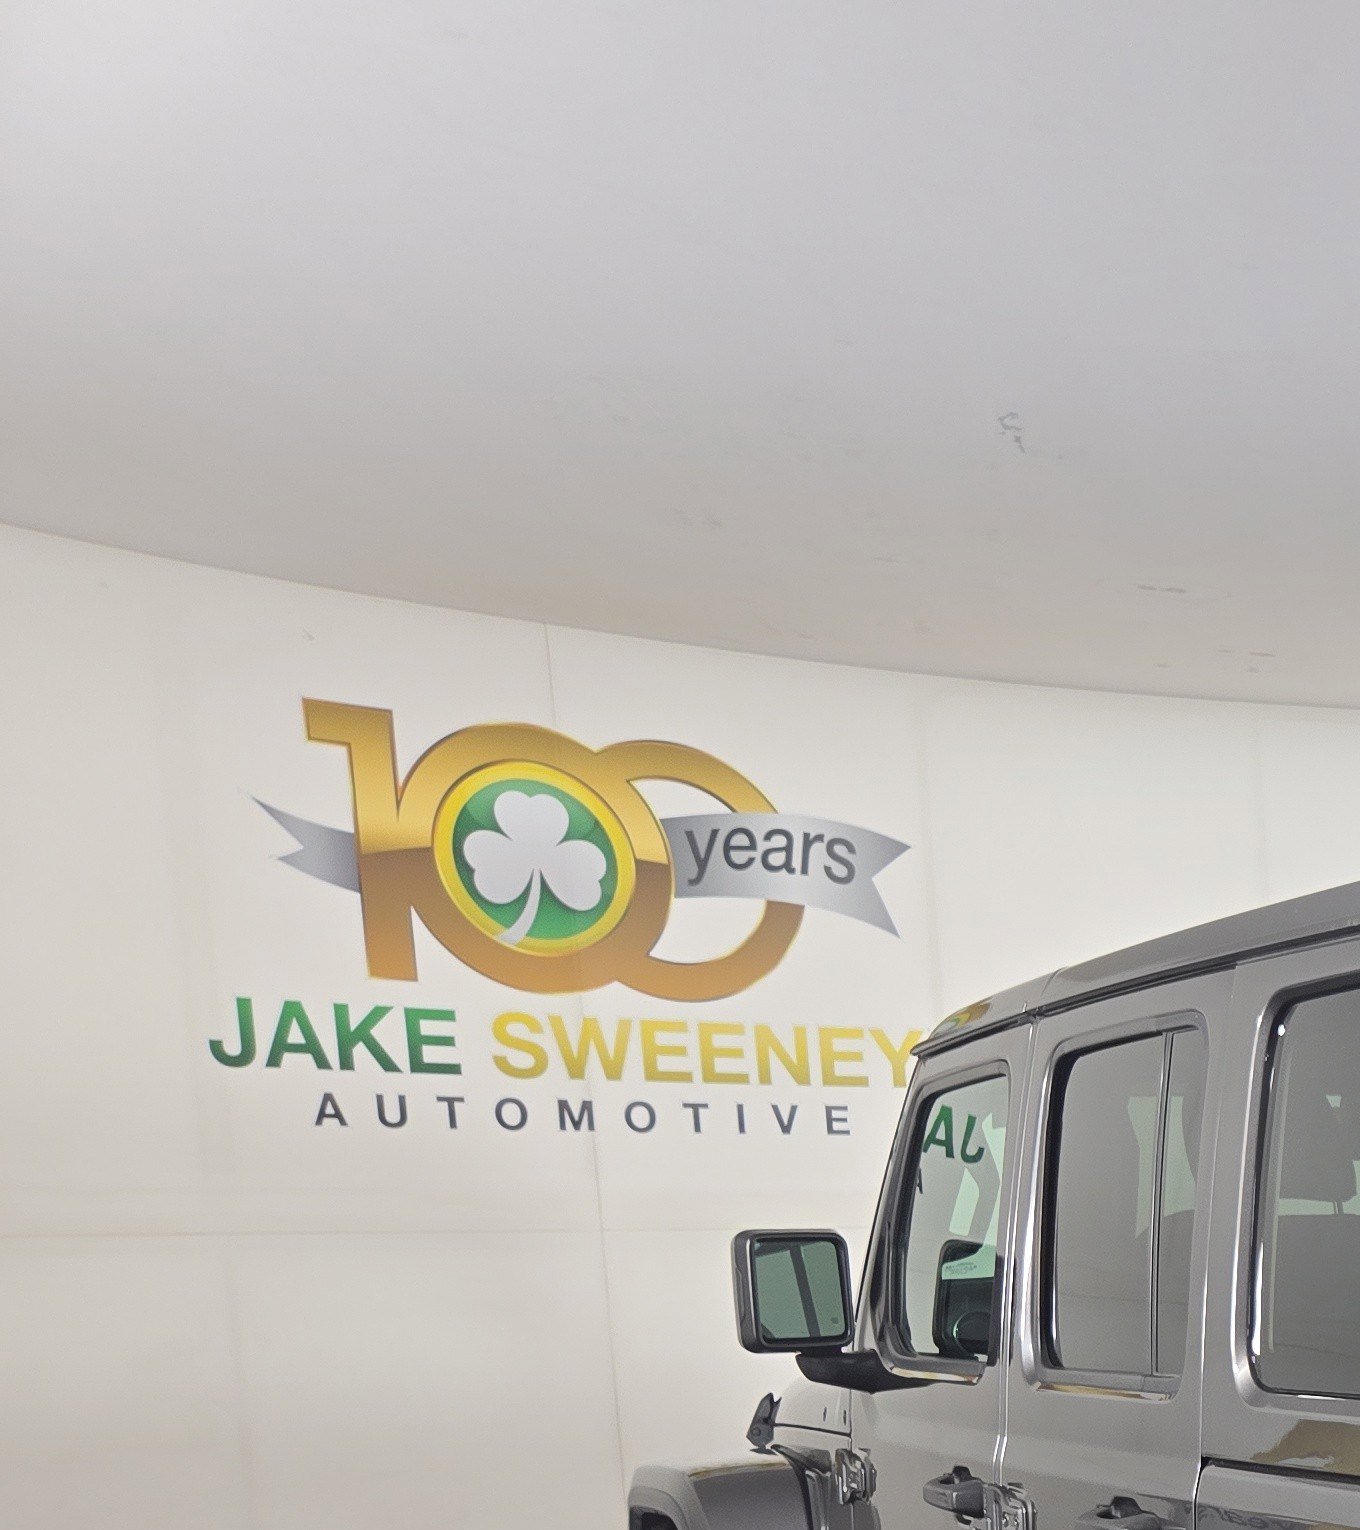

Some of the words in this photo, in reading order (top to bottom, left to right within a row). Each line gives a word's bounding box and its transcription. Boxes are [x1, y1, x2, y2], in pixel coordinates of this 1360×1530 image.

[302, 697, 806, 1002] 100
[685, 823, 857, 884] years
[208, 996, 462, 1076] JAKE
[491, 1012, 928, 1089] SWEENEY
[314, 1091, 851, 1136] AUTOMOTIVE
